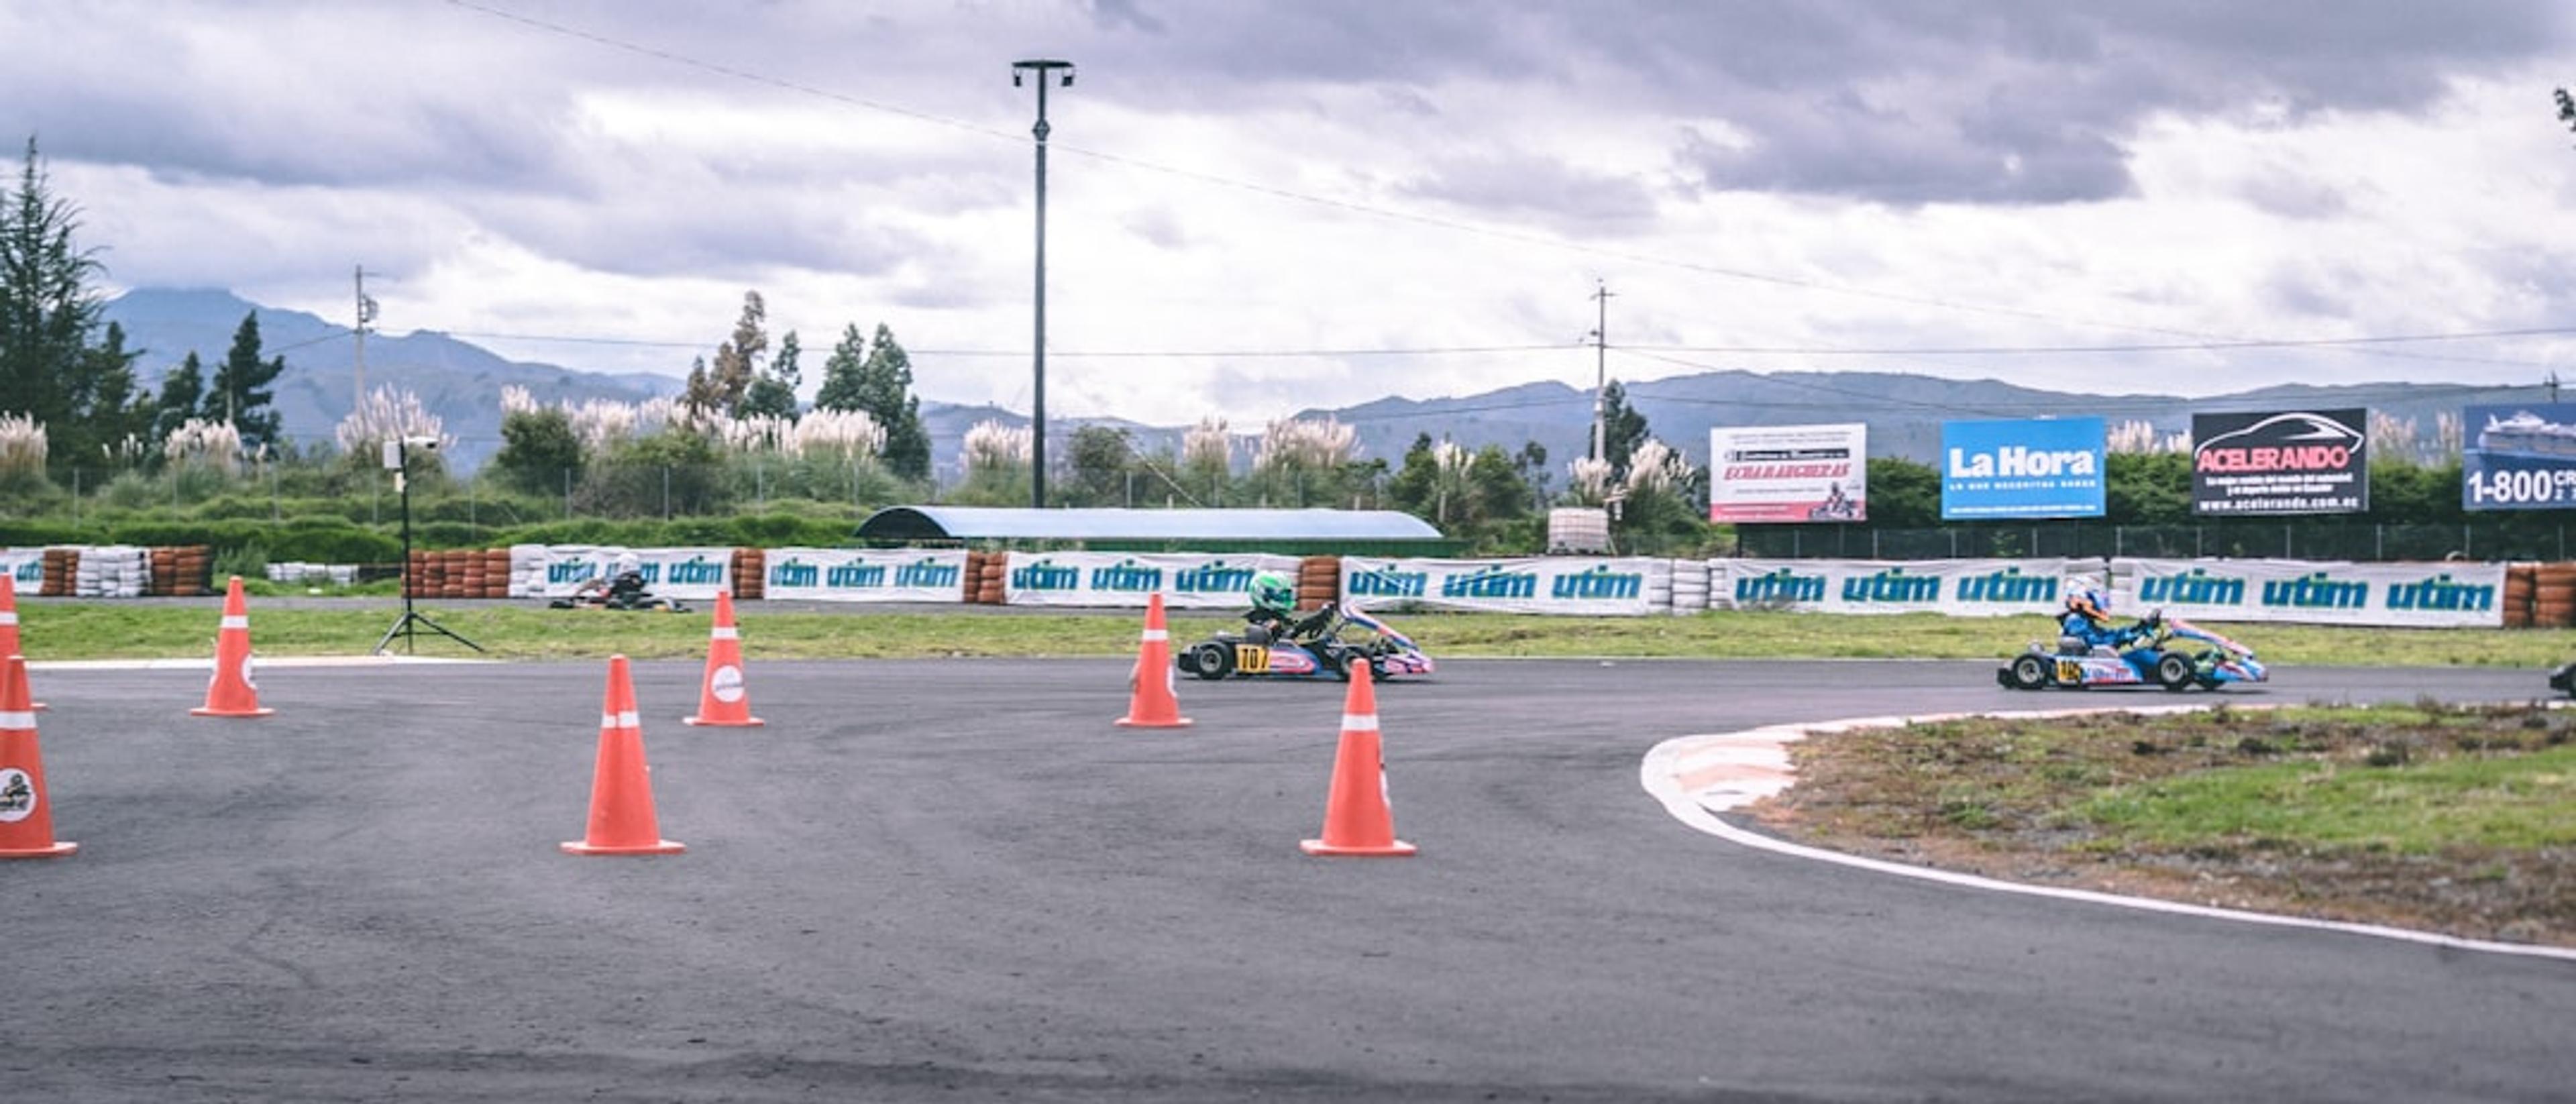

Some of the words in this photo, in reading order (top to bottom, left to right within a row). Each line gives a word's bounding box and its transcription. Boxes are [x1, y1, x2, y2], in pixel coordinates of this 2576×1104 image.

[1949, 447, 1994, 478] La
[1998, 445, 2095, 477] Hora
[2197, 446, 2350, 472] ACELERANDO
[1968, 482, 1990, 490] QUE
[2468, 470, 2553, 502] 1-800
[2199, 497, 2358, 511] www.acelerando.com.ec
[667, 555, 723, 584] utim
[770, 557, 818, 587] utim
[826, 557, 885, 587] utim
[895, 557, 959, 588] utim
[1012, 559, 1079, 590] utim
[1091, 559, 1162, 591] utim
[1348, 565, 1427, 598] utim
[1442, 564, 1538, 599] utim
[1551, 565, 1642, 599] utim
[1734, 567, 1826, 602] utim
[1841, 567, 1941, 602] utim
[1956, 566, 2059, 603] utim
[2139, 568, 2245, 606] utim
[2261, 572, 2369, 609] utim
[2385, 573, 2495, 612] utim
